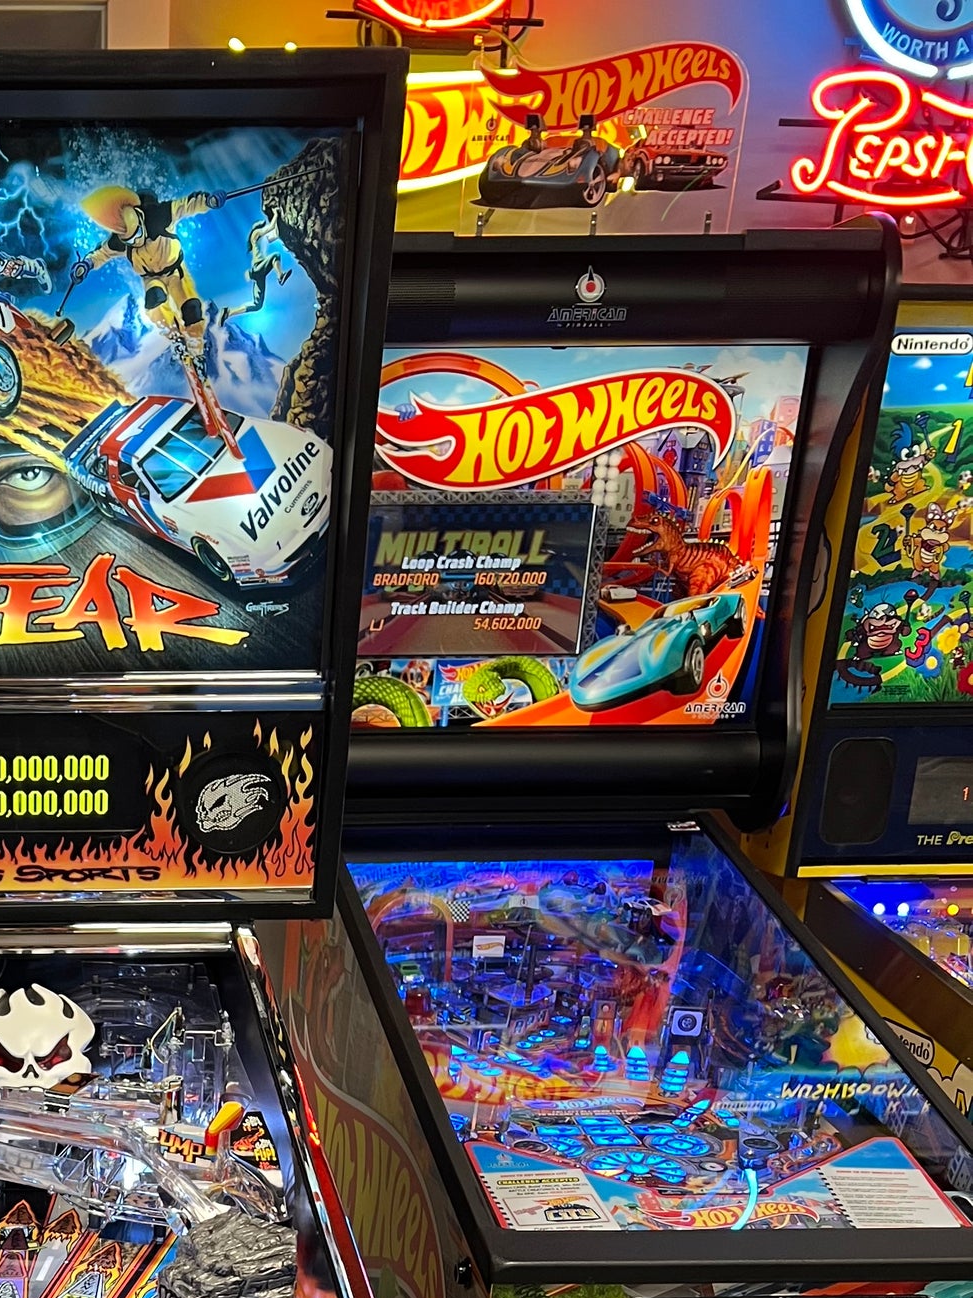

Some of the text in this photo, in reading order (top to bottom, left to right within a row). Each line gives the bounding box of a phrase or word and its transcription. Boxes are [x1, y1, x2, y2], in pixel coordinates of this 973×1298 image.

[881, 22, 970, 61] WORTH A
[538, 68, 616, 126] HOT
[624, 109, 714, 125] CHALLENGE
[645, 129, 733, 146] ACCEPTED!
[791, 70, 973, 193] PEPSI-
[546, 307, 627, 322] AMERICAN
[897, 337, 969, 351] Nintendo
[444, 406, 557, 484] HOT
[944, 418, 962, 454] 1
[239, 441, 320, 543] Valvoline
[283, 479, 313, 514] Cummins
[401, 555, 523, 571] Loop Crash Champ
[373, 571, 548, 587] BRADFORD 160,720,000
[390, 600, 525, 617] Track Builder Champ
[473, 616, 543, 631] 54,602,000
[905, 627, 931, 660] 3
[685, 701, 746, 714] AMERICAN
[917, 834, 944, 846] THE
[12, 864, 162, 883] SPORTS
[691, 1205, 739, 1228] HOT
